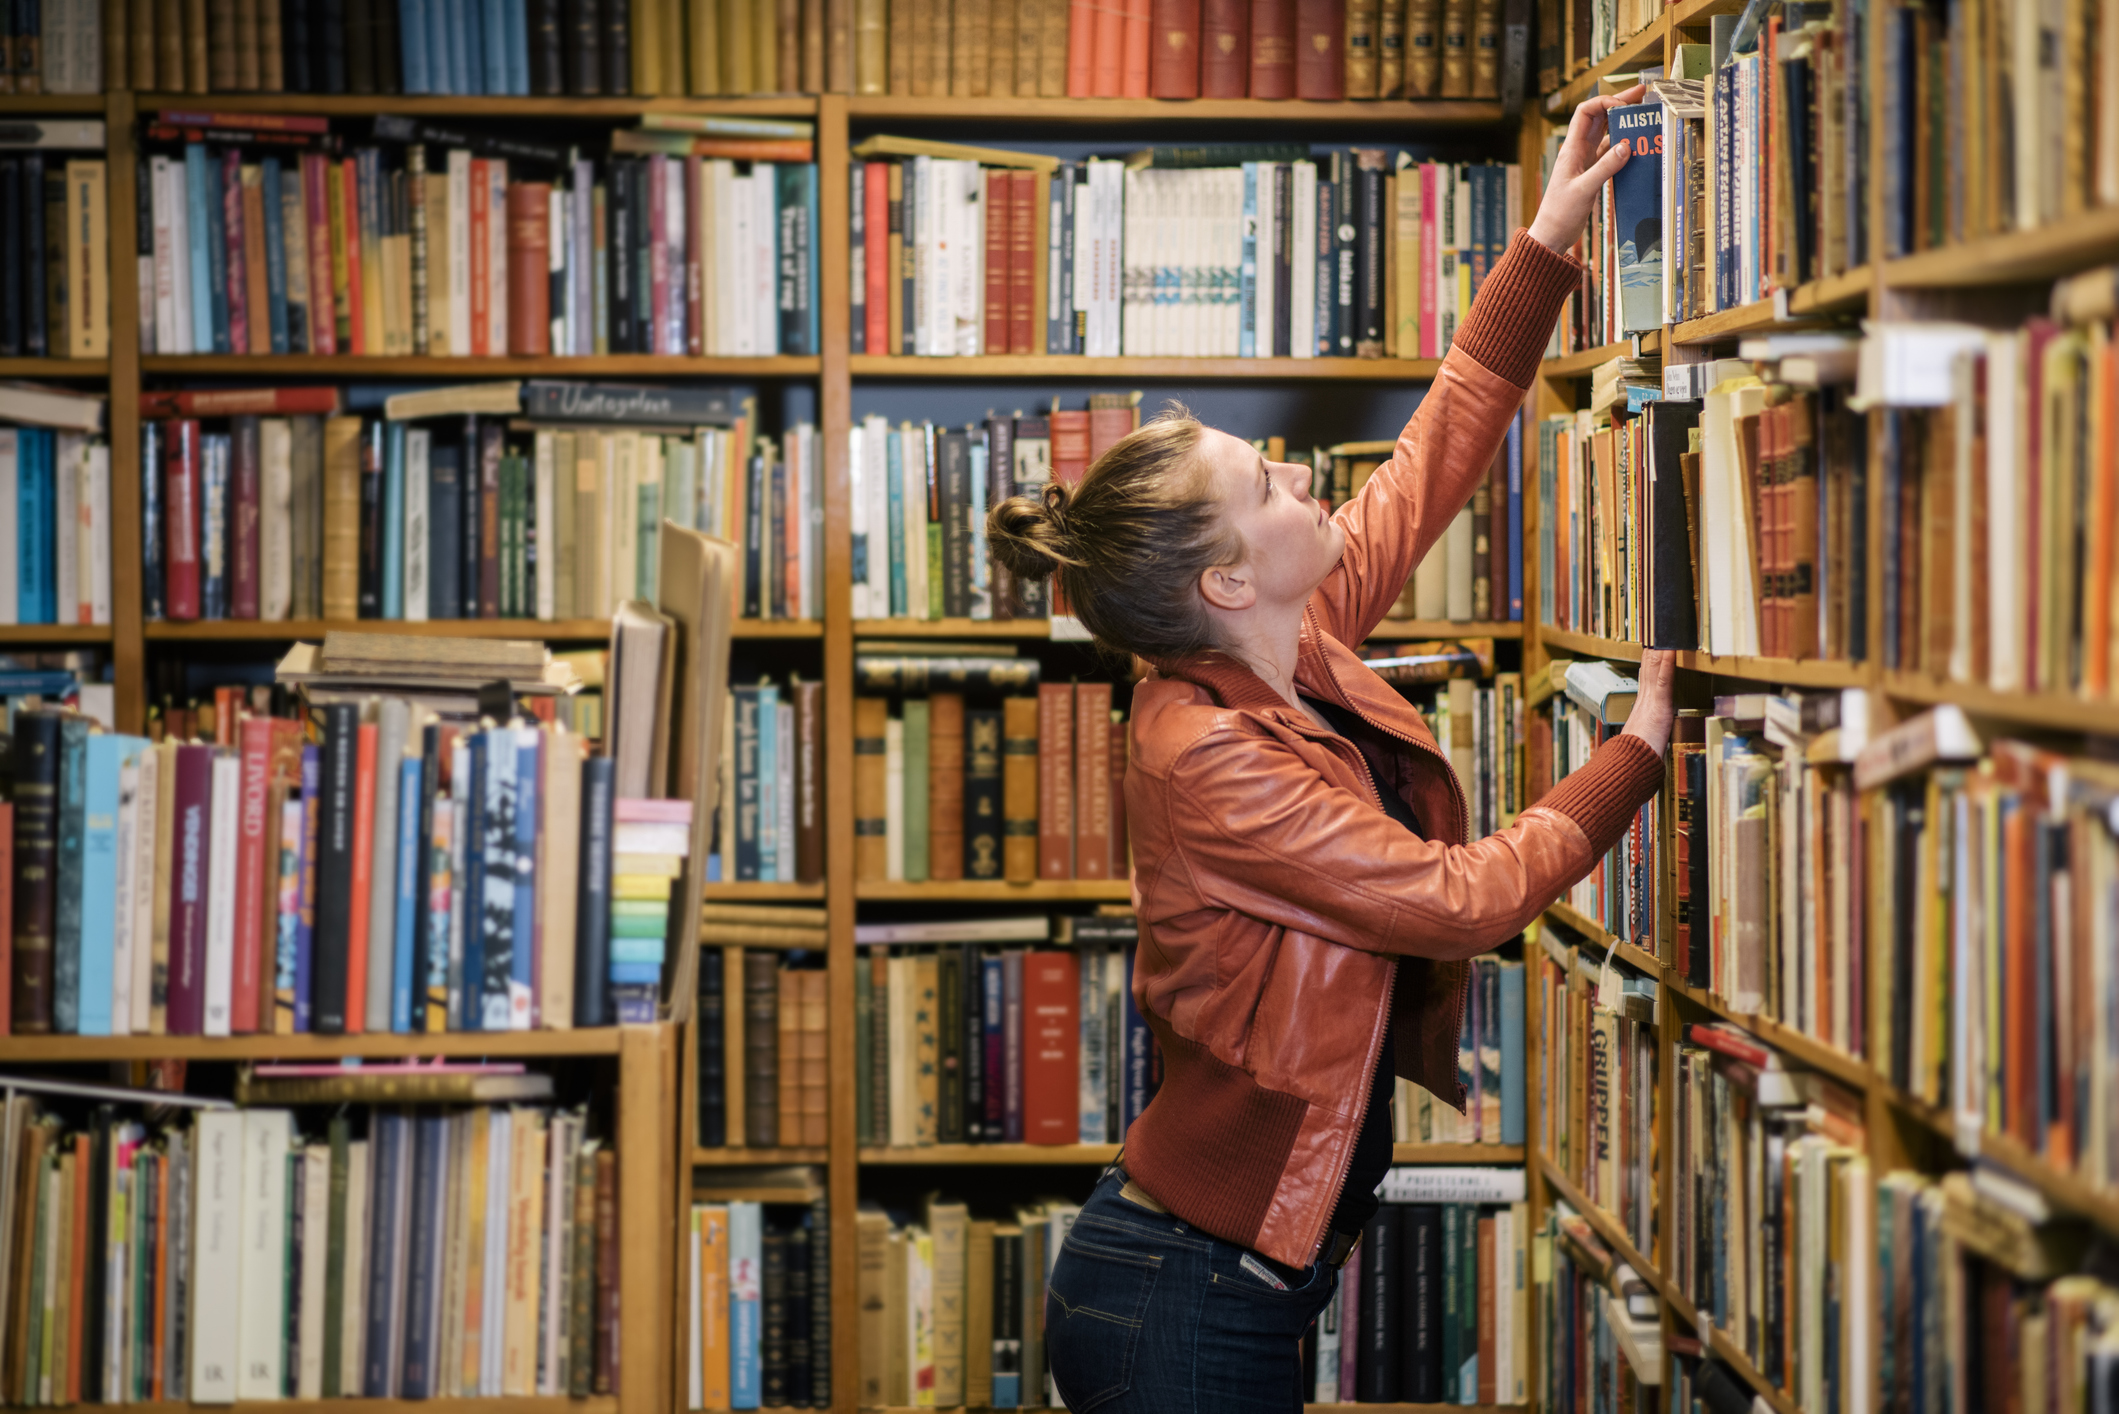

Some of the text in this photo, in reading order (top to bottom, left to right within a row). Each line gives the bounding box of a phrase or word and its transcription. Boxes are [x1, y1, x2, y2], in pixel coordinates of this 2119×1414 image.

[1618, 111, 1663, 130] ALISTA
[1722, 100, 1730, 249] AFTENSTJERNEN
[1733, 95, 1741, 246] AFTENSTJERNEN
[1055, 693, 1070, 749] SELMA
[1092, 693, 1107, 749] SELMA
[244, 751, 265, 837] LIVORD
[1593, 1029, 1609, 1161] GRUPPEN
